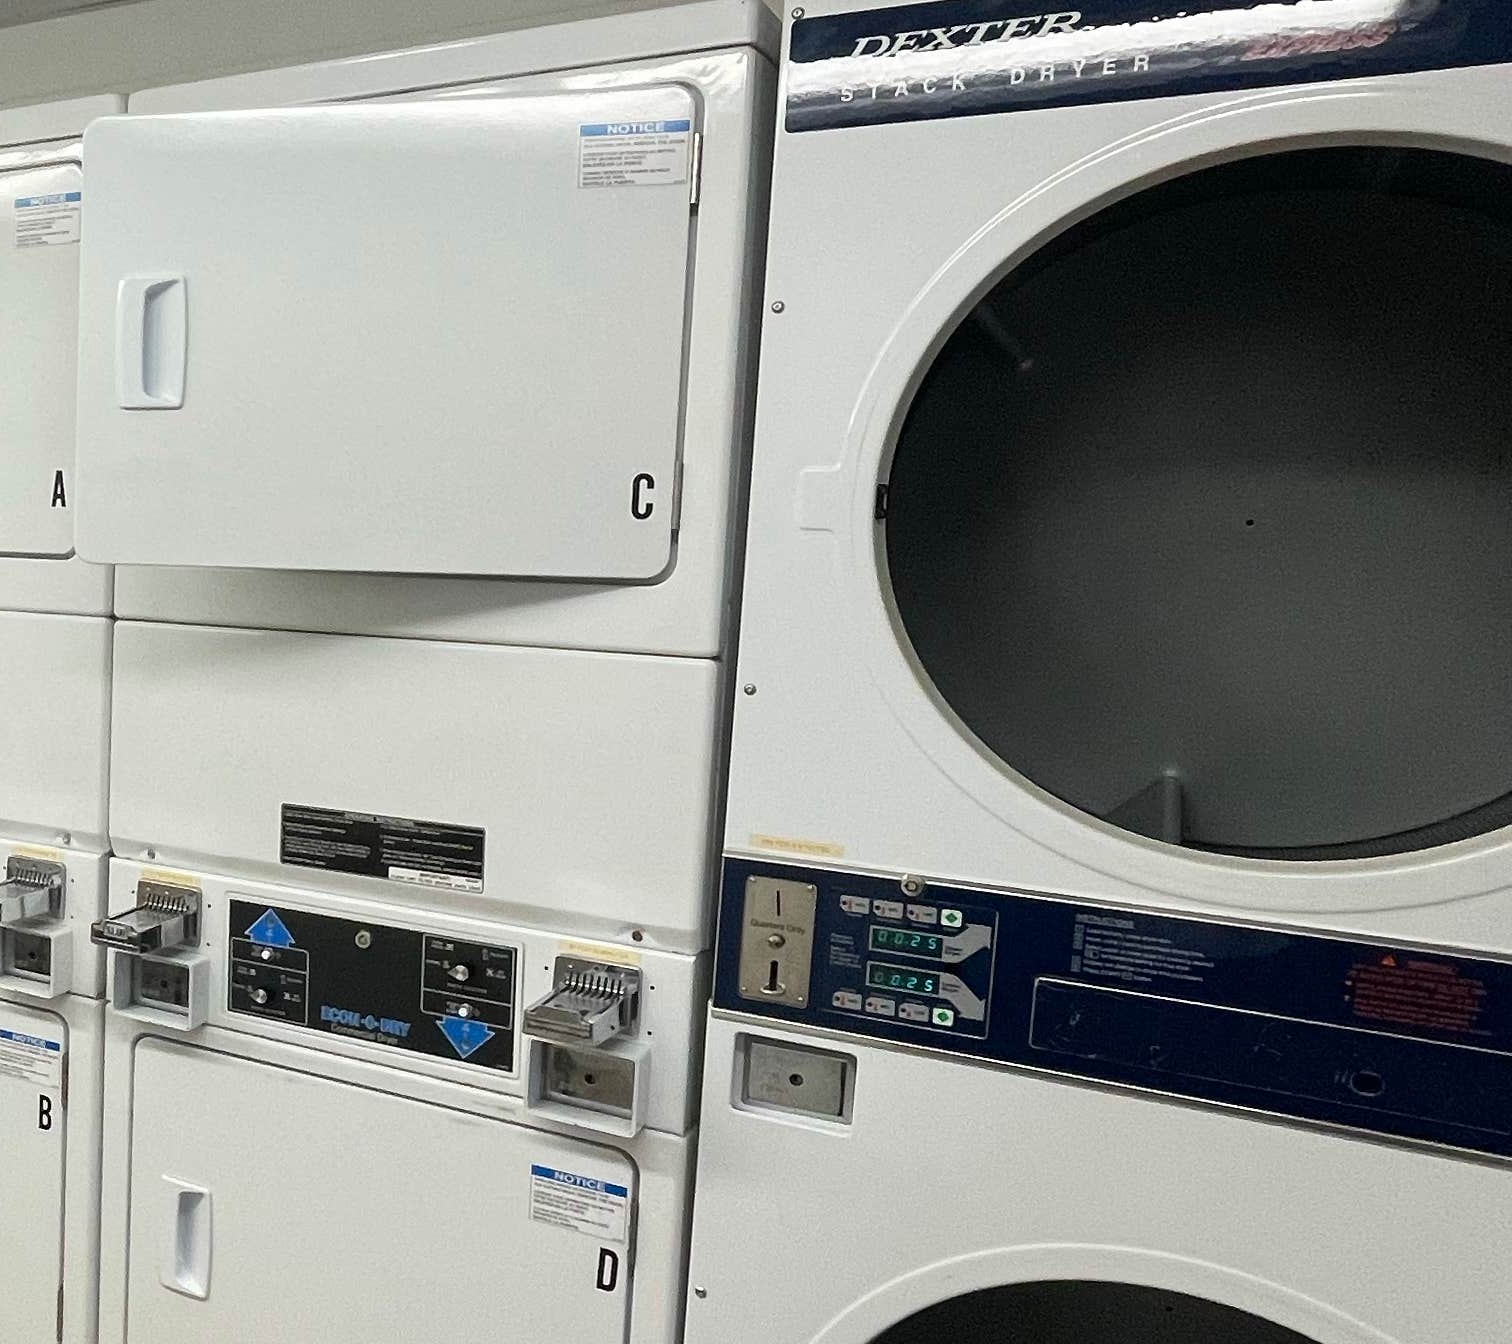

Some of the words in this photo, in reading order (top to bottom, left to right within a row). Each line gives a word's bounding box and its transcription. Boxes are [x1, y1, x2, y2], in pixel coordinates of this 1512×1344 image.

[851, 11, 1082, 58] DEXTER
[840, 75, 968, 103] STACK
[1010, 56, 1150, 86] DRYER
[607, 121, 665, 135] NOTICE
[51, 470, 66, 507] A
[632, 473, 655, 520] C
[38, 1094, 52, 1131] B
[554, 1171, 606, 1193] NOTICE
[596, 1247, 619, 1292] D
